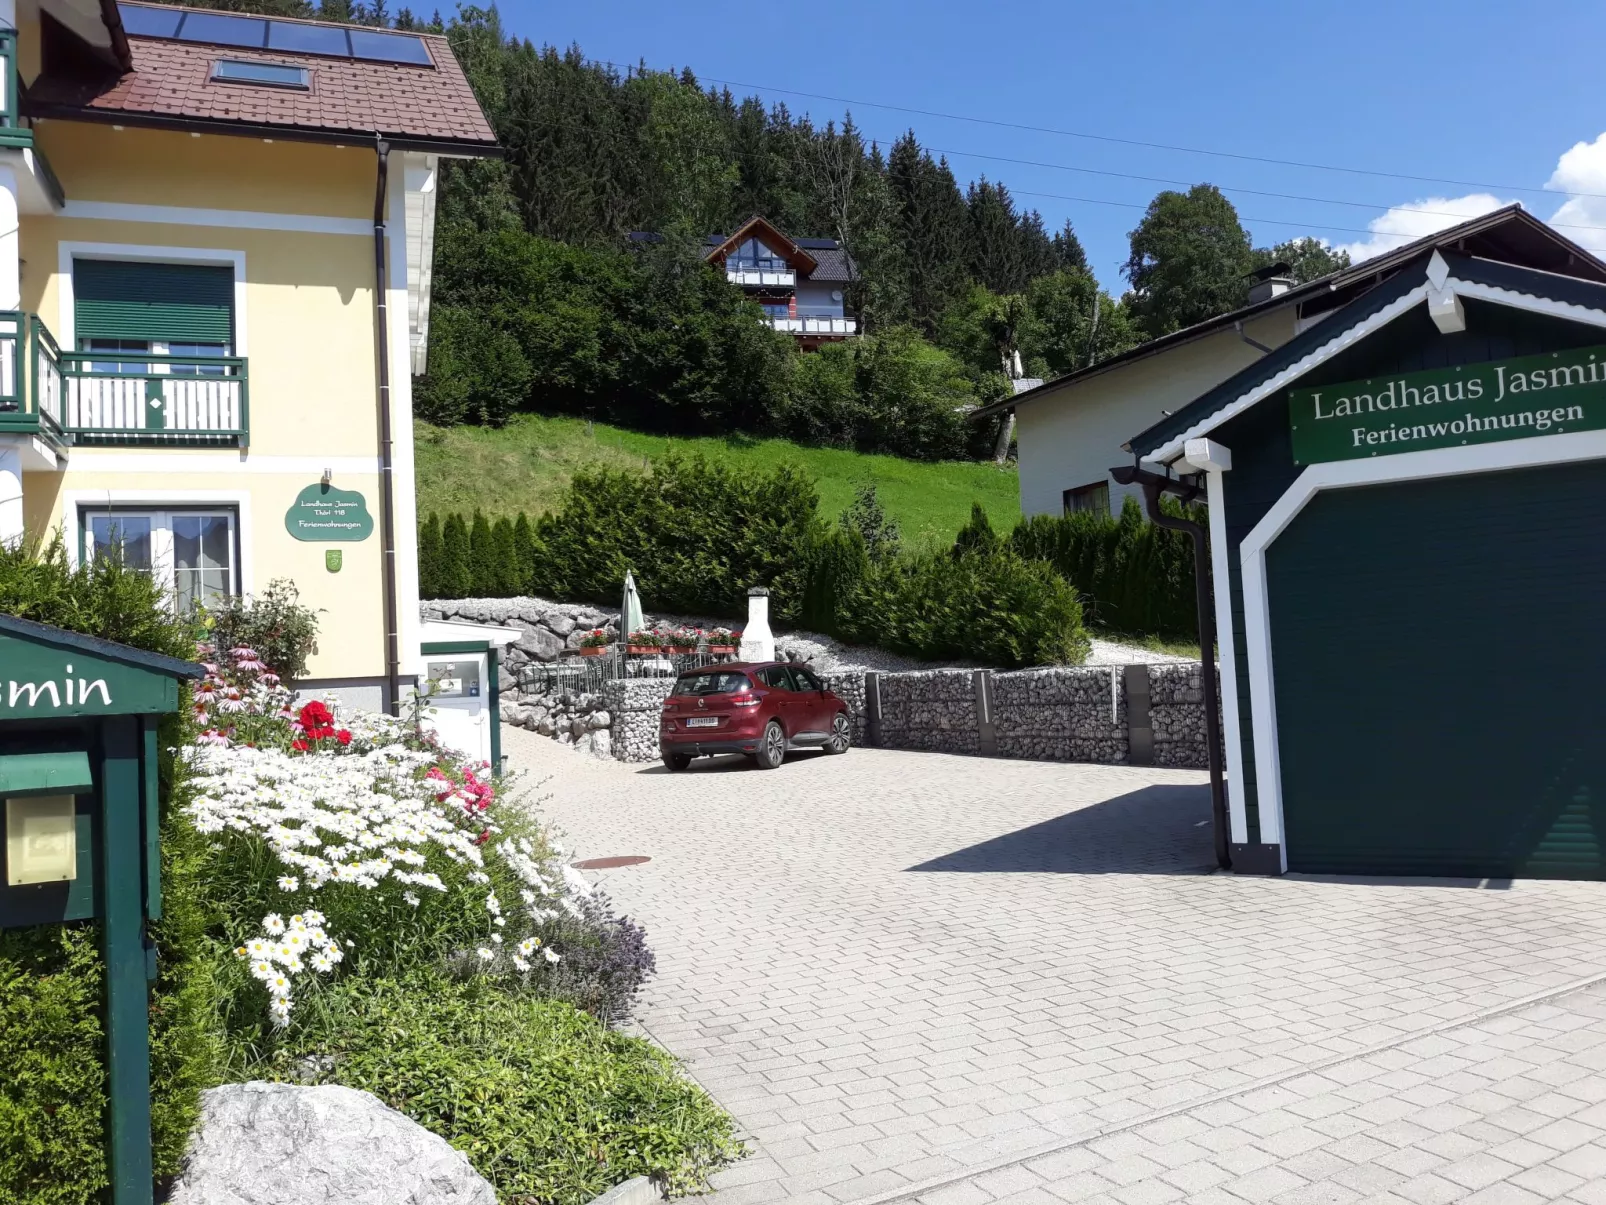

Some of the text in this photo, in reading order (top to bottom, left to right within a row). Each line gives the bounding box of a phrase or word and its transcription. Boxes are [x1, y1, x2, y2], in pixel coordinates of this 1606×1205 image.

[1311, 380, 1484, 420] Landhaus
[1352, 405, 1584, 447] Ferienwohnungen
[299, 520, 361, 529] Ferienwohnungen
[0, 664, 113, 708] min
